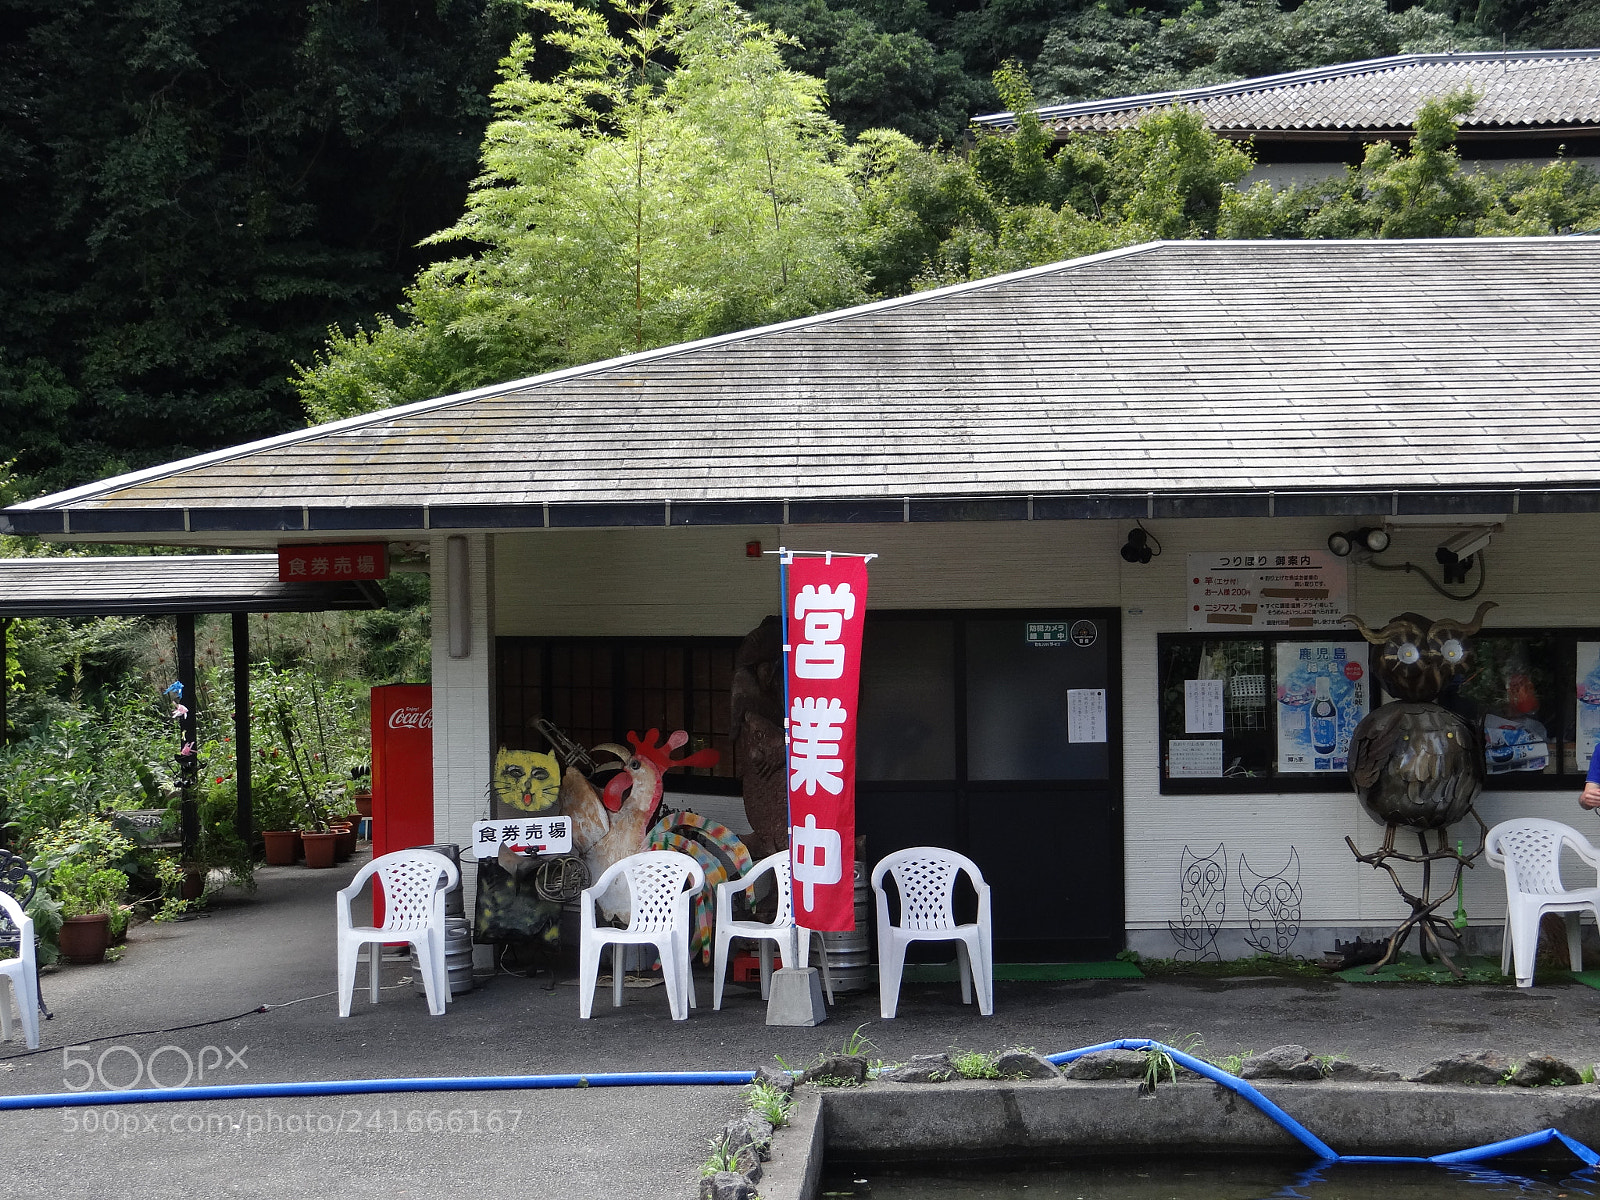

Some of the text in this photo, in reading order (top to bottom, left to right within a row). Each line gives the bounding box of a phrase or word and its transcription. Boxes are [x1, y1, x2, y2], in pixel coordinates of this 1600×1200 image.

[288, 555, 376, 576] 食券売場
[1275, 555, 1311, 566] 御案内
[1299, 647, 1347, 660] 鹿児島
[790, 583, 856, 913] 営業中
[478, 822, 567, 843] 食券売場
